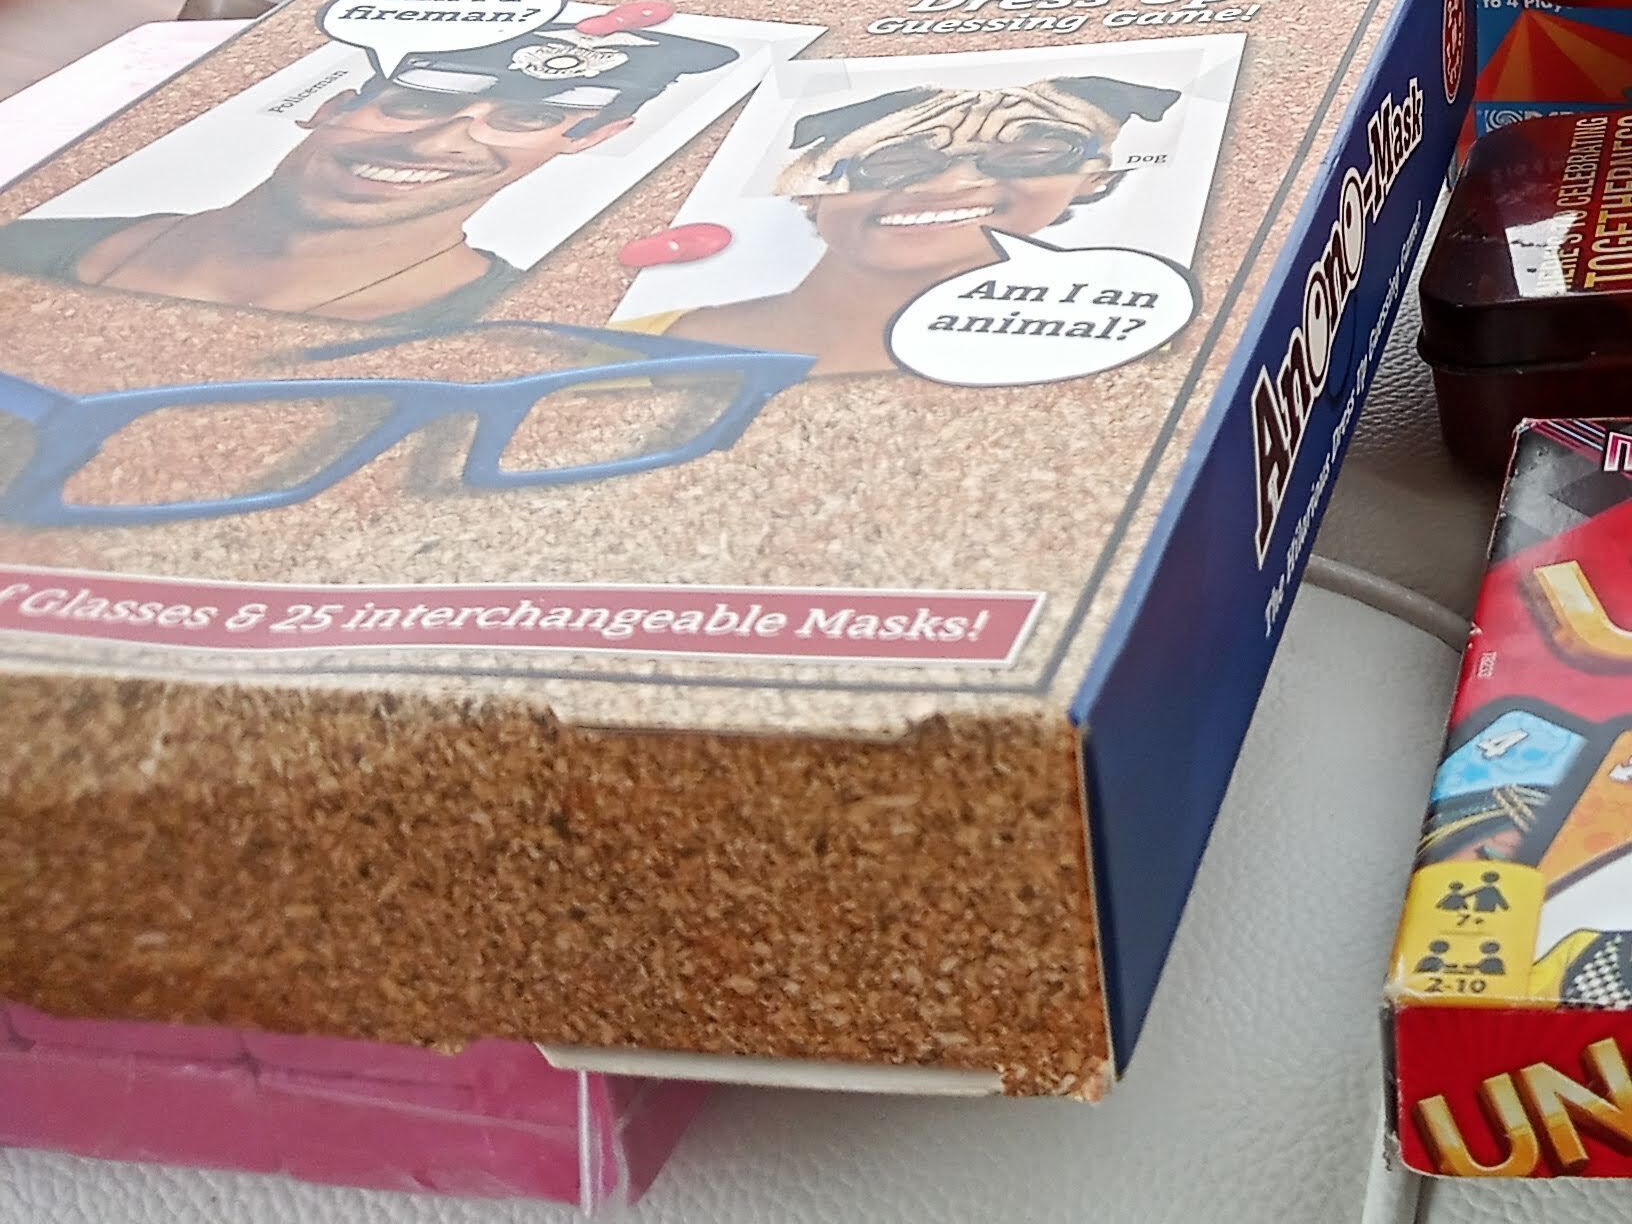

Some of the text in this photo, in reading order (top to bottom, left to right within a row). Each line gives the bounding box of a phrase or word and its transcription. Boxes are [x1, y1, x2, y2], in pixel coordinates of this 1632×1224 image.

[339, 5, 540, 24] fireman?
[867, 4, 1262, 35] Guessing Game!
[268, 69, 349, 113] Policeman
[1126, 151, 1169, 166] Dog
[1556, 116, 1609, 206] CELEBRATING
[959, 279, 1159, 309] Am I an
[927, 311, 1146, 342] animal?
[1266, 574, 1285, 637] The
[1286, 452, 1331, 583] Hilarious
[1331, 388, 1356, 464] Dress
[1368, 265, 1399, 360] Guessing
[20, 587, 218, 631] Glasses
[226, 603, 269, 632] &
[270, 604, 346, 633] 25
[341, 599, 788, 639] interchangeable
[794, 606, 990, 643] Masks!
[1477, 729, 1529, 761] 4
[1455, 913, 1486, 928] 7+
[1424, 975, 1488, 995] 2-10
